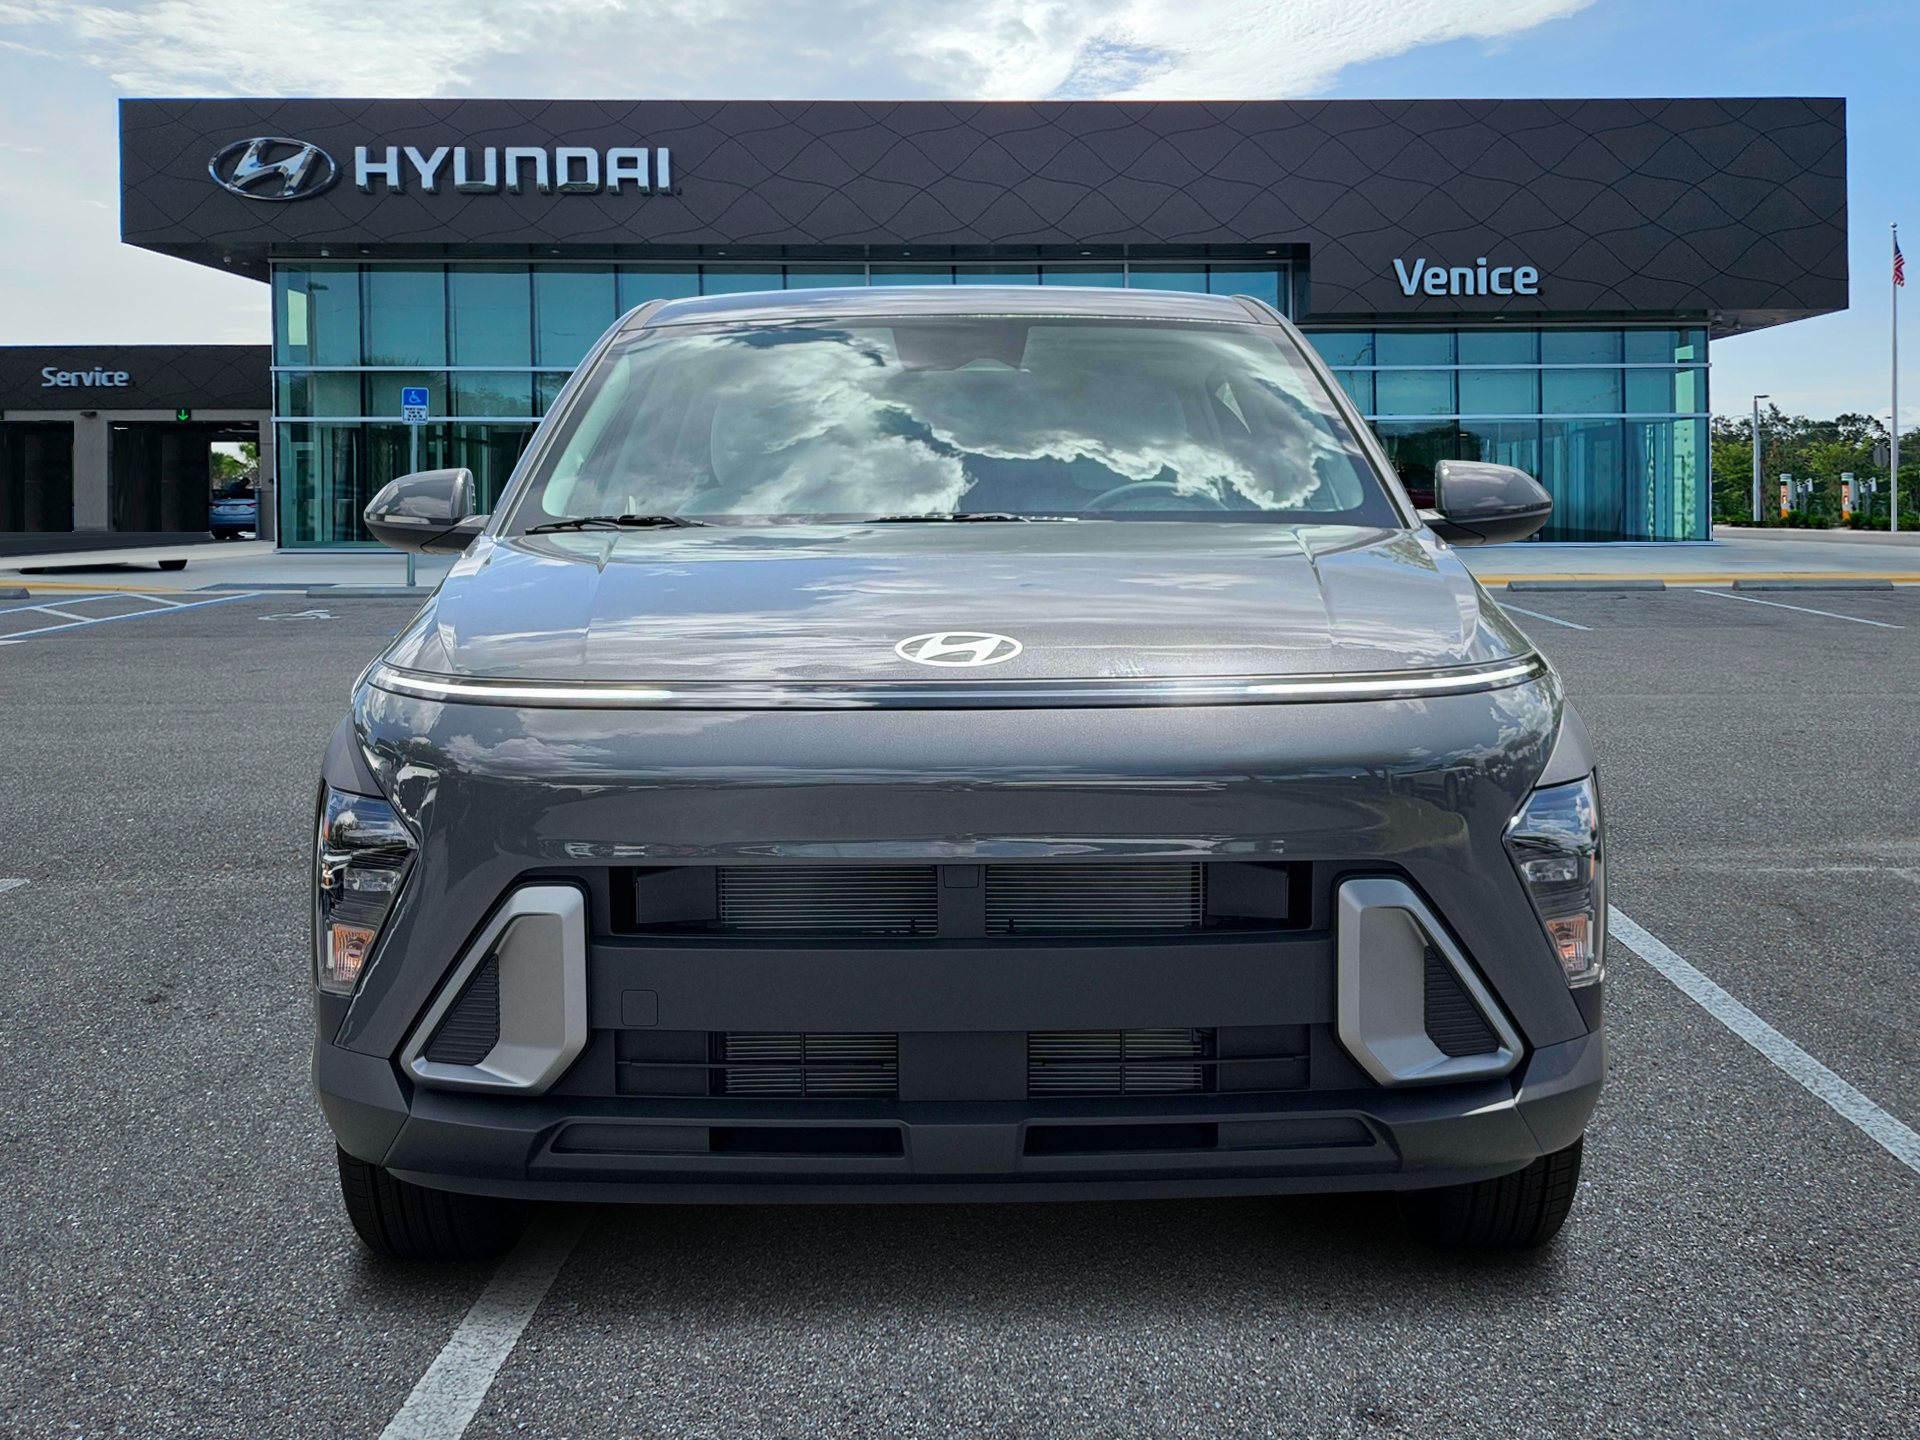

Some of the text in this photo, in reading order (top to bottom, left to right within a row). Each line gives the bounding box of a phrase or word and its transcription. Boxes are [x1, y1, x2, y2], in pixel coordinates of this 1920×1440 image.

[354, 145, 672, 195] HYUNDAI
[1393, 257, 1540, 296] Venice
[41, 366, 129, 388] Service
